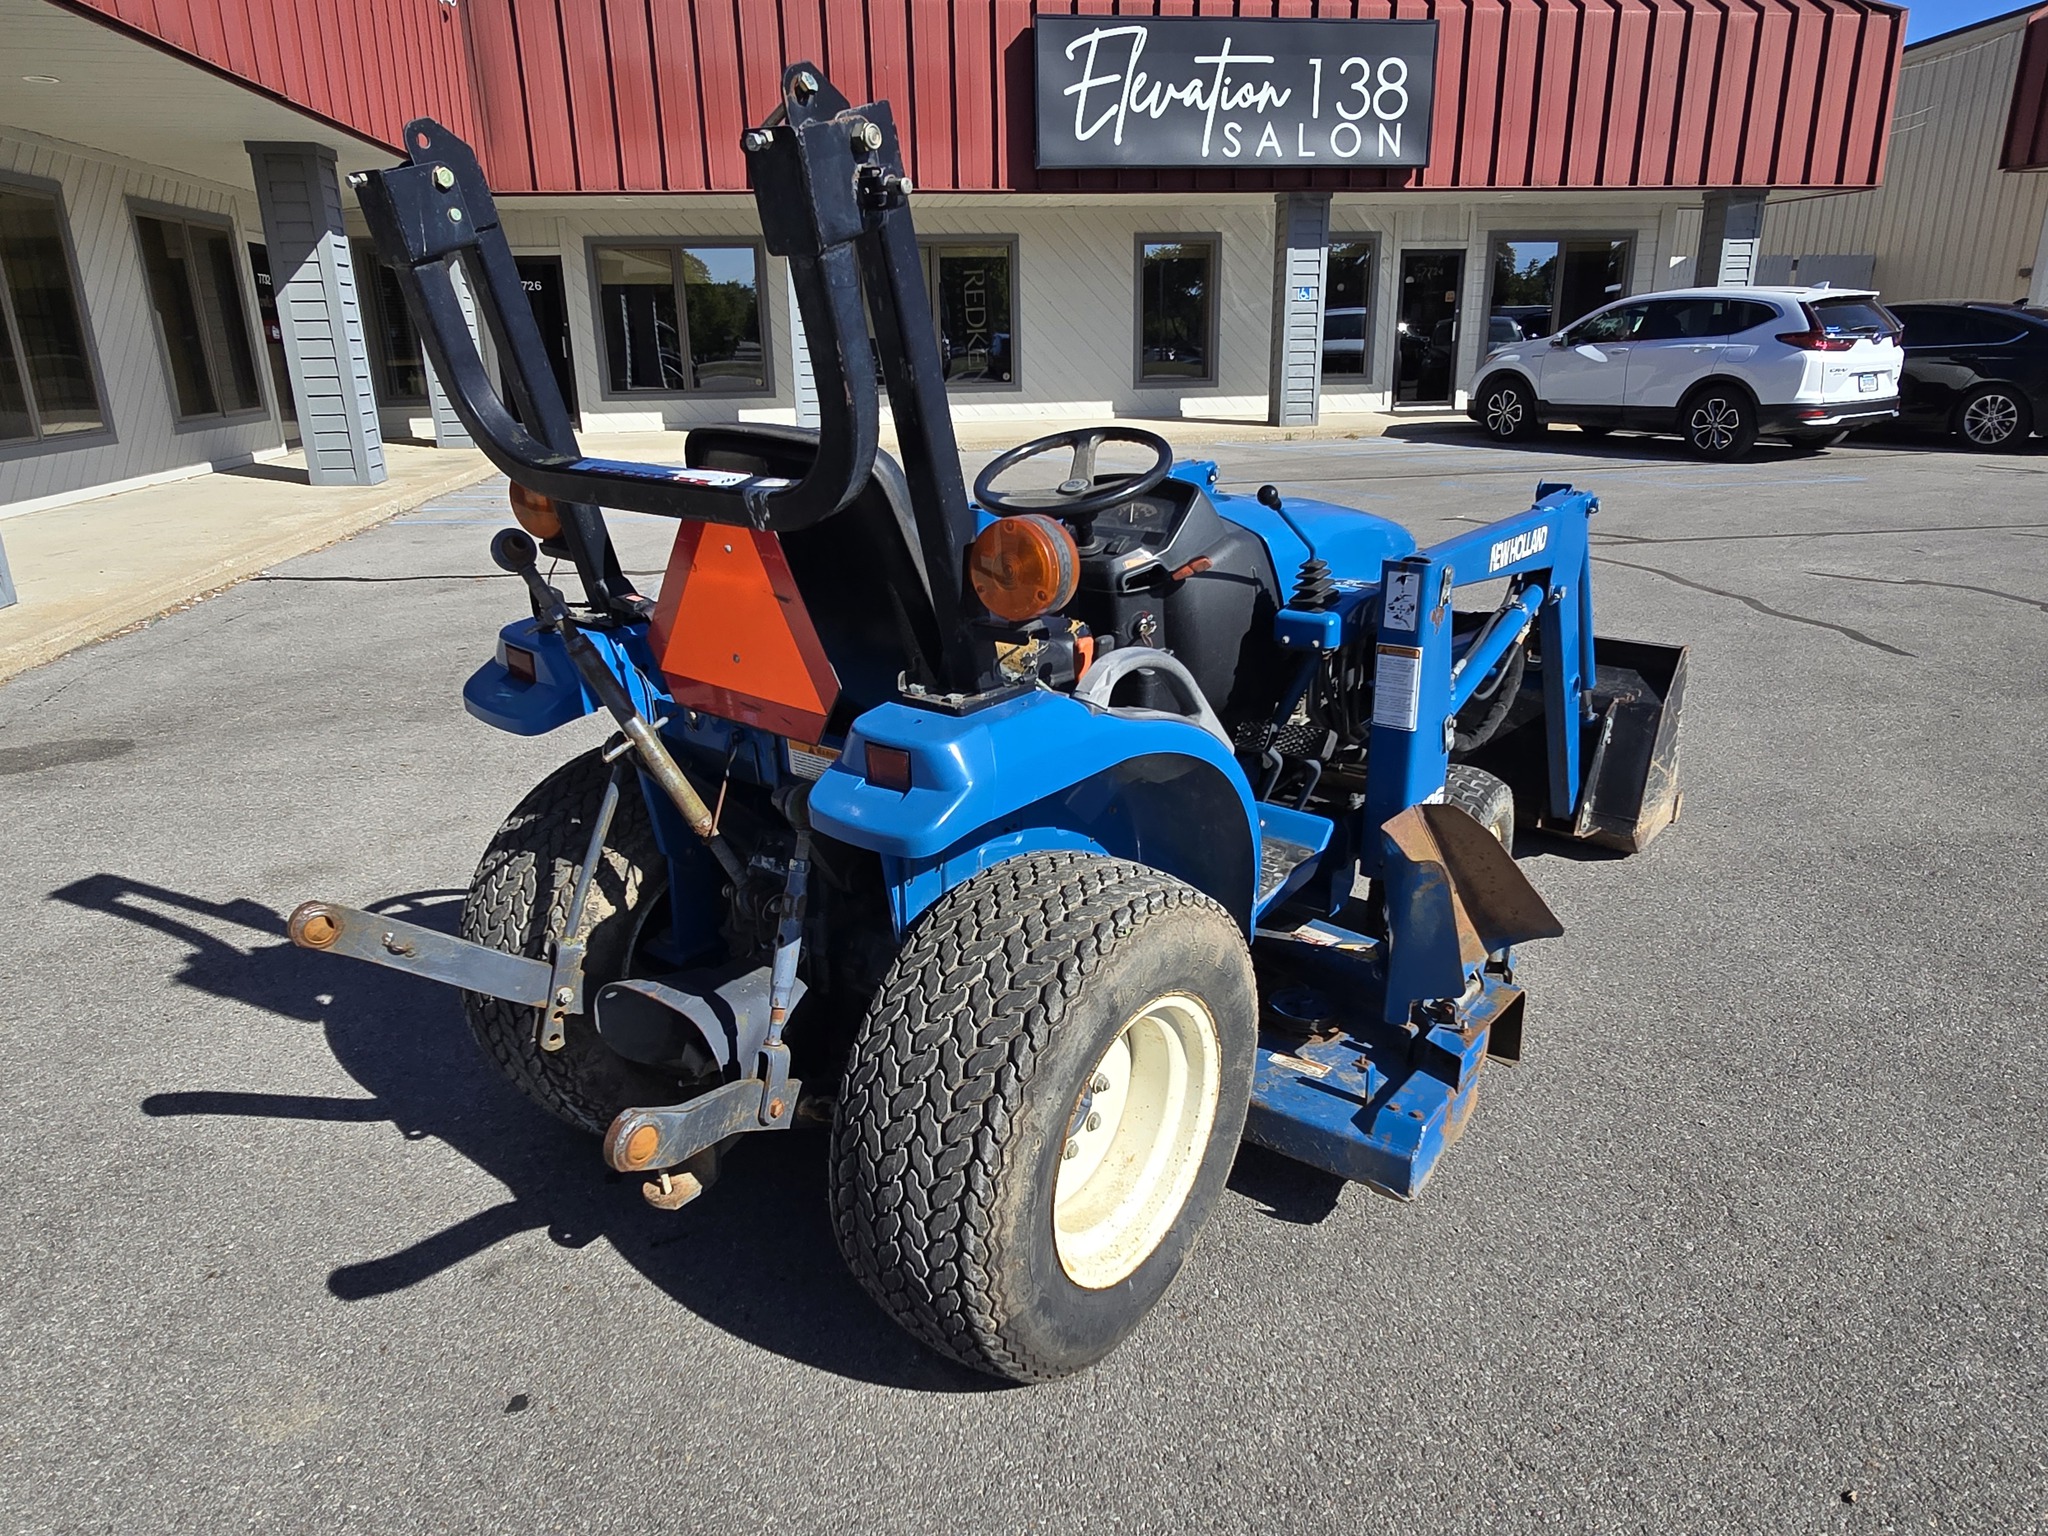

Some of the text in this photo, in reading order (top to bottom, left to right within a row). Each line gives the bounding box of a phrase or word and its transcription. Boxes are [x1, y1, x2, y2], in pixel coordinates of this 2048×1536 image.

[1063, 24, 1410, 158] Elevation 138
[1222, 121, 1402, 158] SALON
[1489, 525, 1549, 573] NEW HOLLAND
